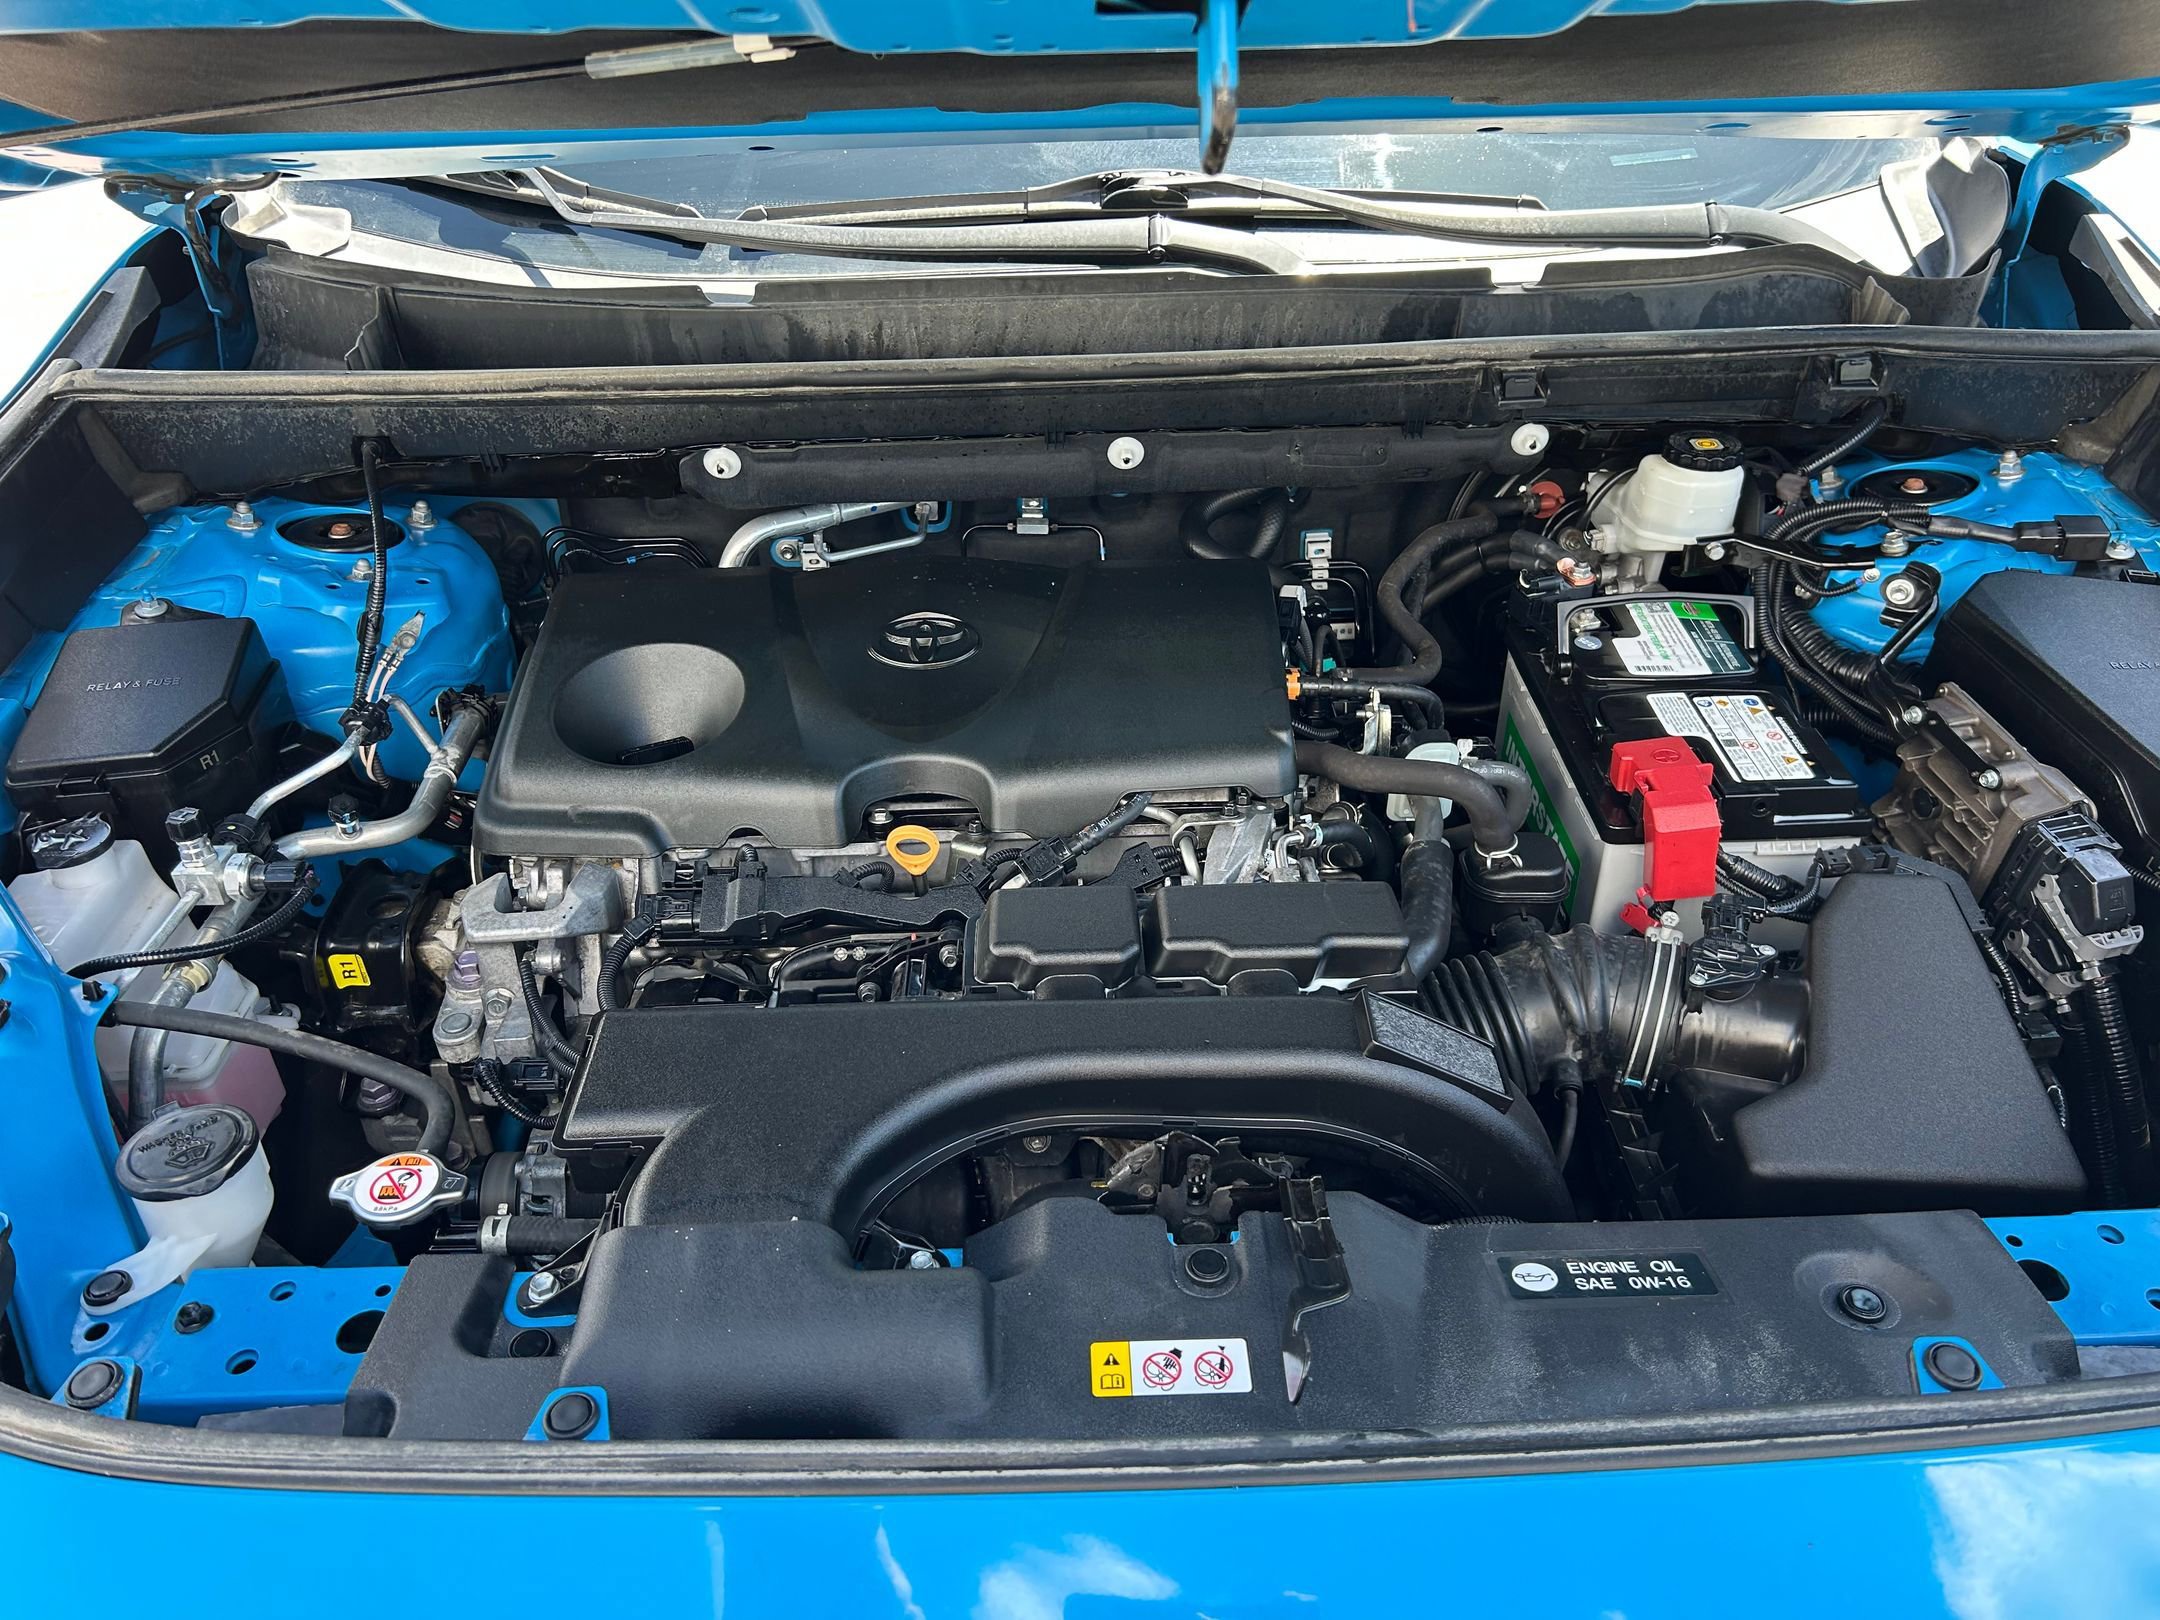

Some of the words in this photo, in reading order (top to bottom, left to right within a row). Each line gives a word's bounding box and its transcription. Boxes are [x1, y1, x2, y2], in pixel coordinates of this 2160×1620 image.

[2109, 661, 2152, 670] RELAY
[86, 680, 131, 692] RELAY
[132, 680, 141, 688] &
[145, 676, 182, 687] FUSE
[199, 749, 220, 770] R1
[339, 961, 357, 979] R1
[1566, 1261, 1640, 1275] ENGINE
[1650, 1260, 1685, 1273] OIL
[1574, 1277, 1617, 1290] SAE
[1628, 1275, 1693, 1289] 0W-16
